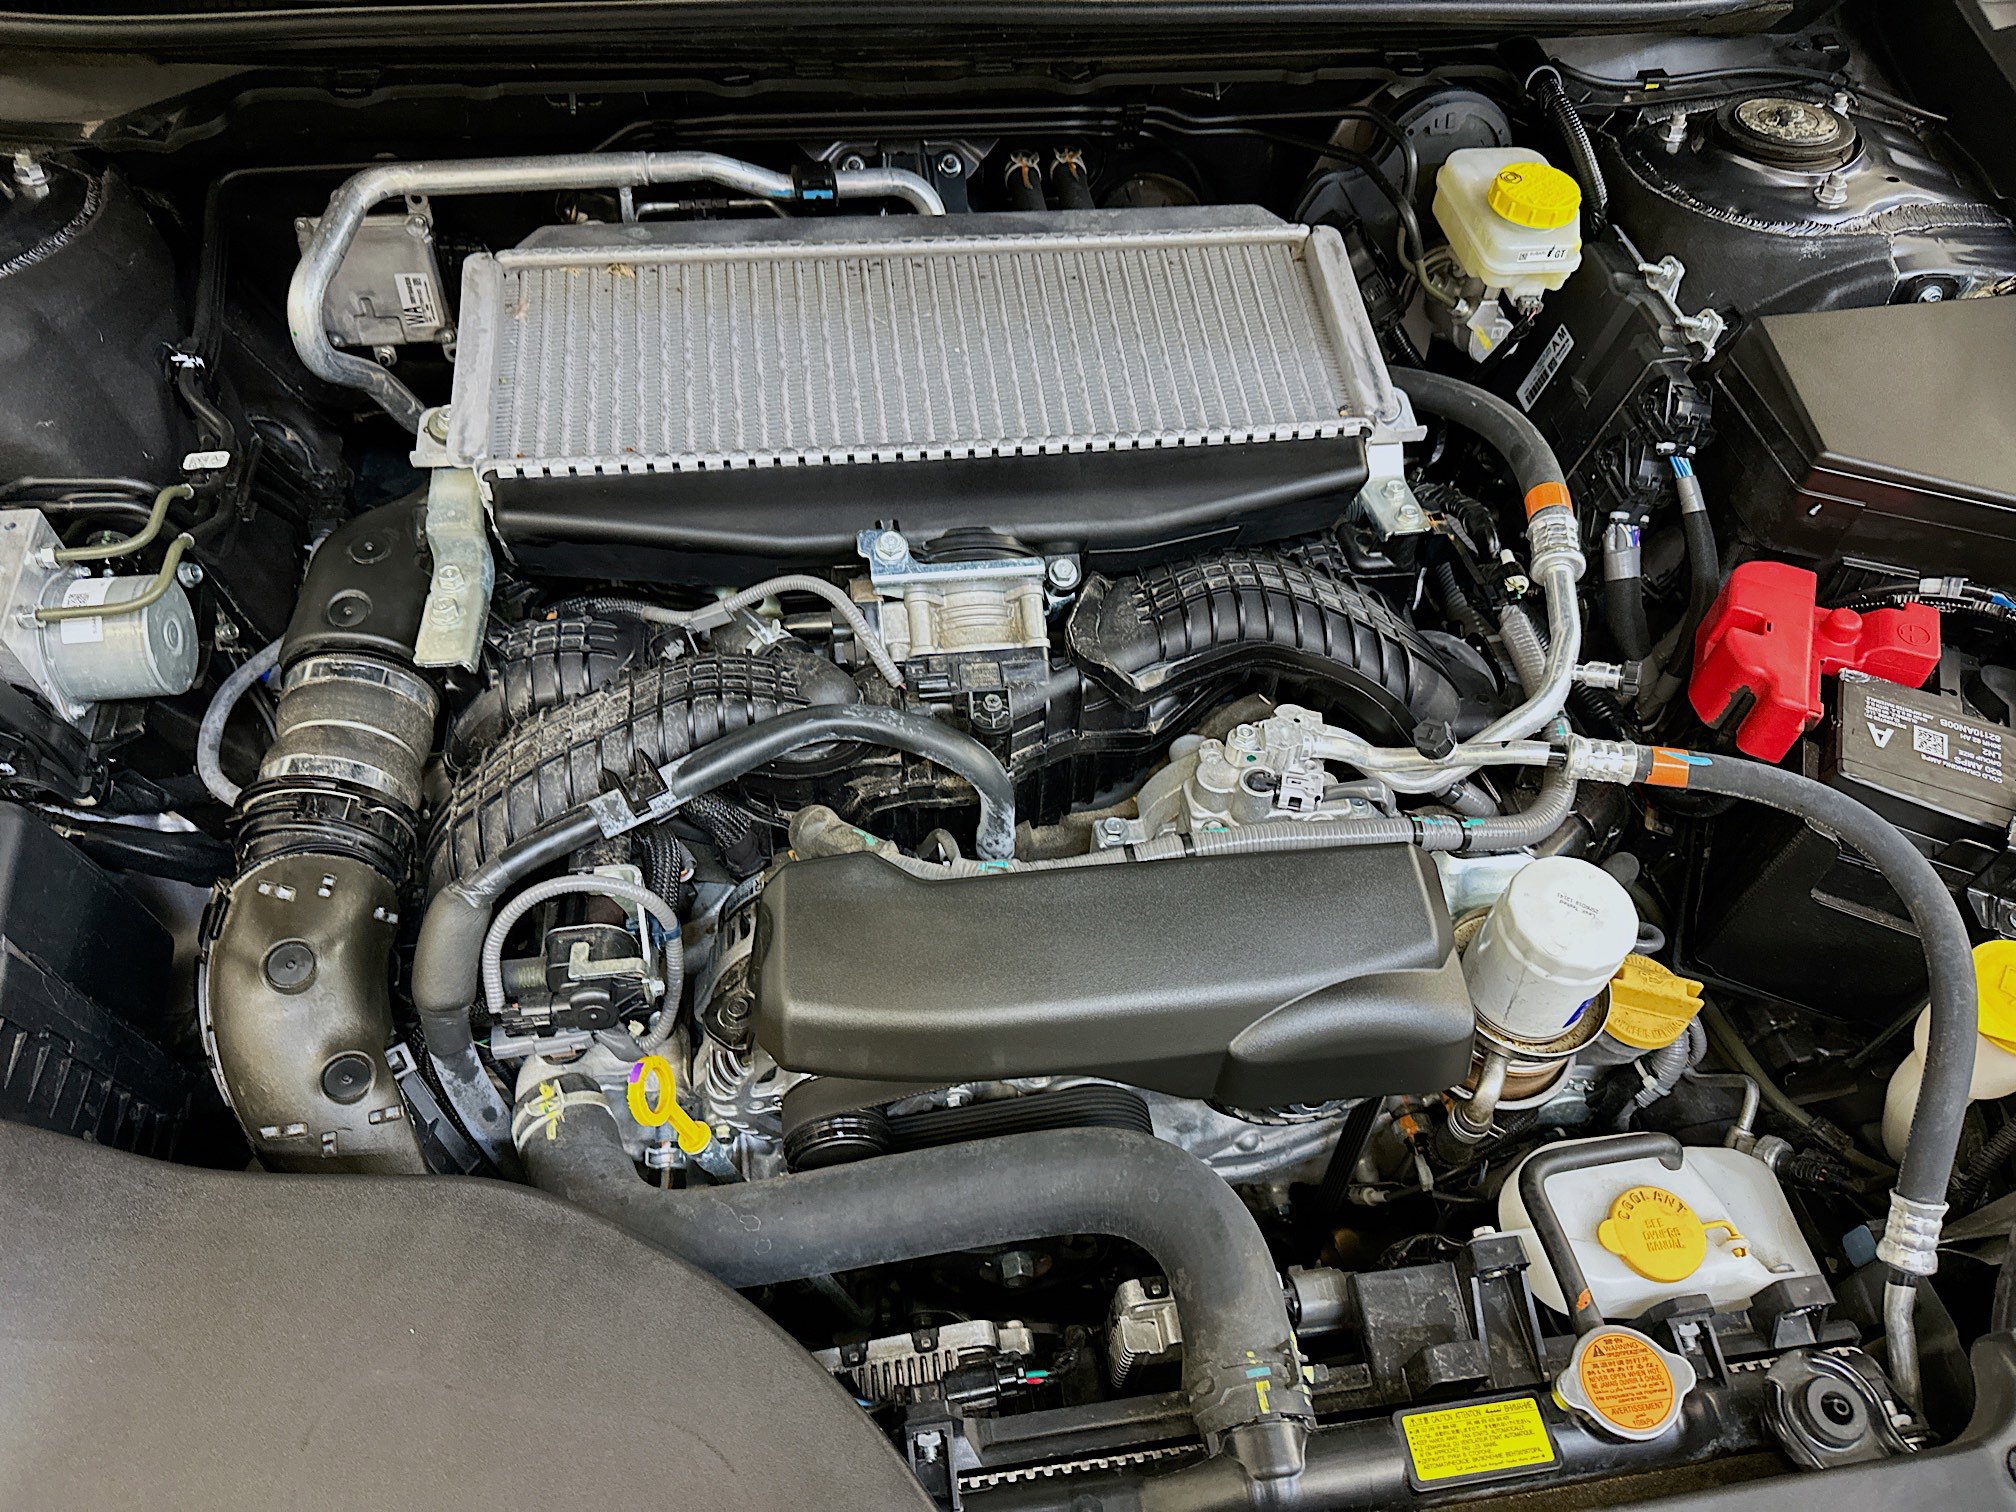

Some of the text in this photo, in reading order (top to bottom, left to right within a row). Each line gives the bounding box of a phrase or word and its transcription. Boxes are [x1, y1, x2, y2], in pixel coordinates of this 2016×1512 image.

[1982, 748, 2001, 759] LN2
[1954, 756, 1982, 771] AMPS
[1976, 754, 2002, 767] GROUP
[1943, 760, 1981, 777] CRANKING
[1982, 772, 2002, 783] COLD
[1559, 900, 1579, 912] Tested
[1618, 1190, 1688, 1220] COOLANT
[1645, 1218, 1664, 1229] SEE
[1646, 1238, 1686, 1252] MANUAL
[1603, 1342, 1638, 1352] WARNING
[1589, 1375, 1608, 1383] NEVER
[1611, 1402, 1664, 1415] AVERTISSEMENT
[1430, 1409, 1482, 1423] CAUTION ATTENTION
